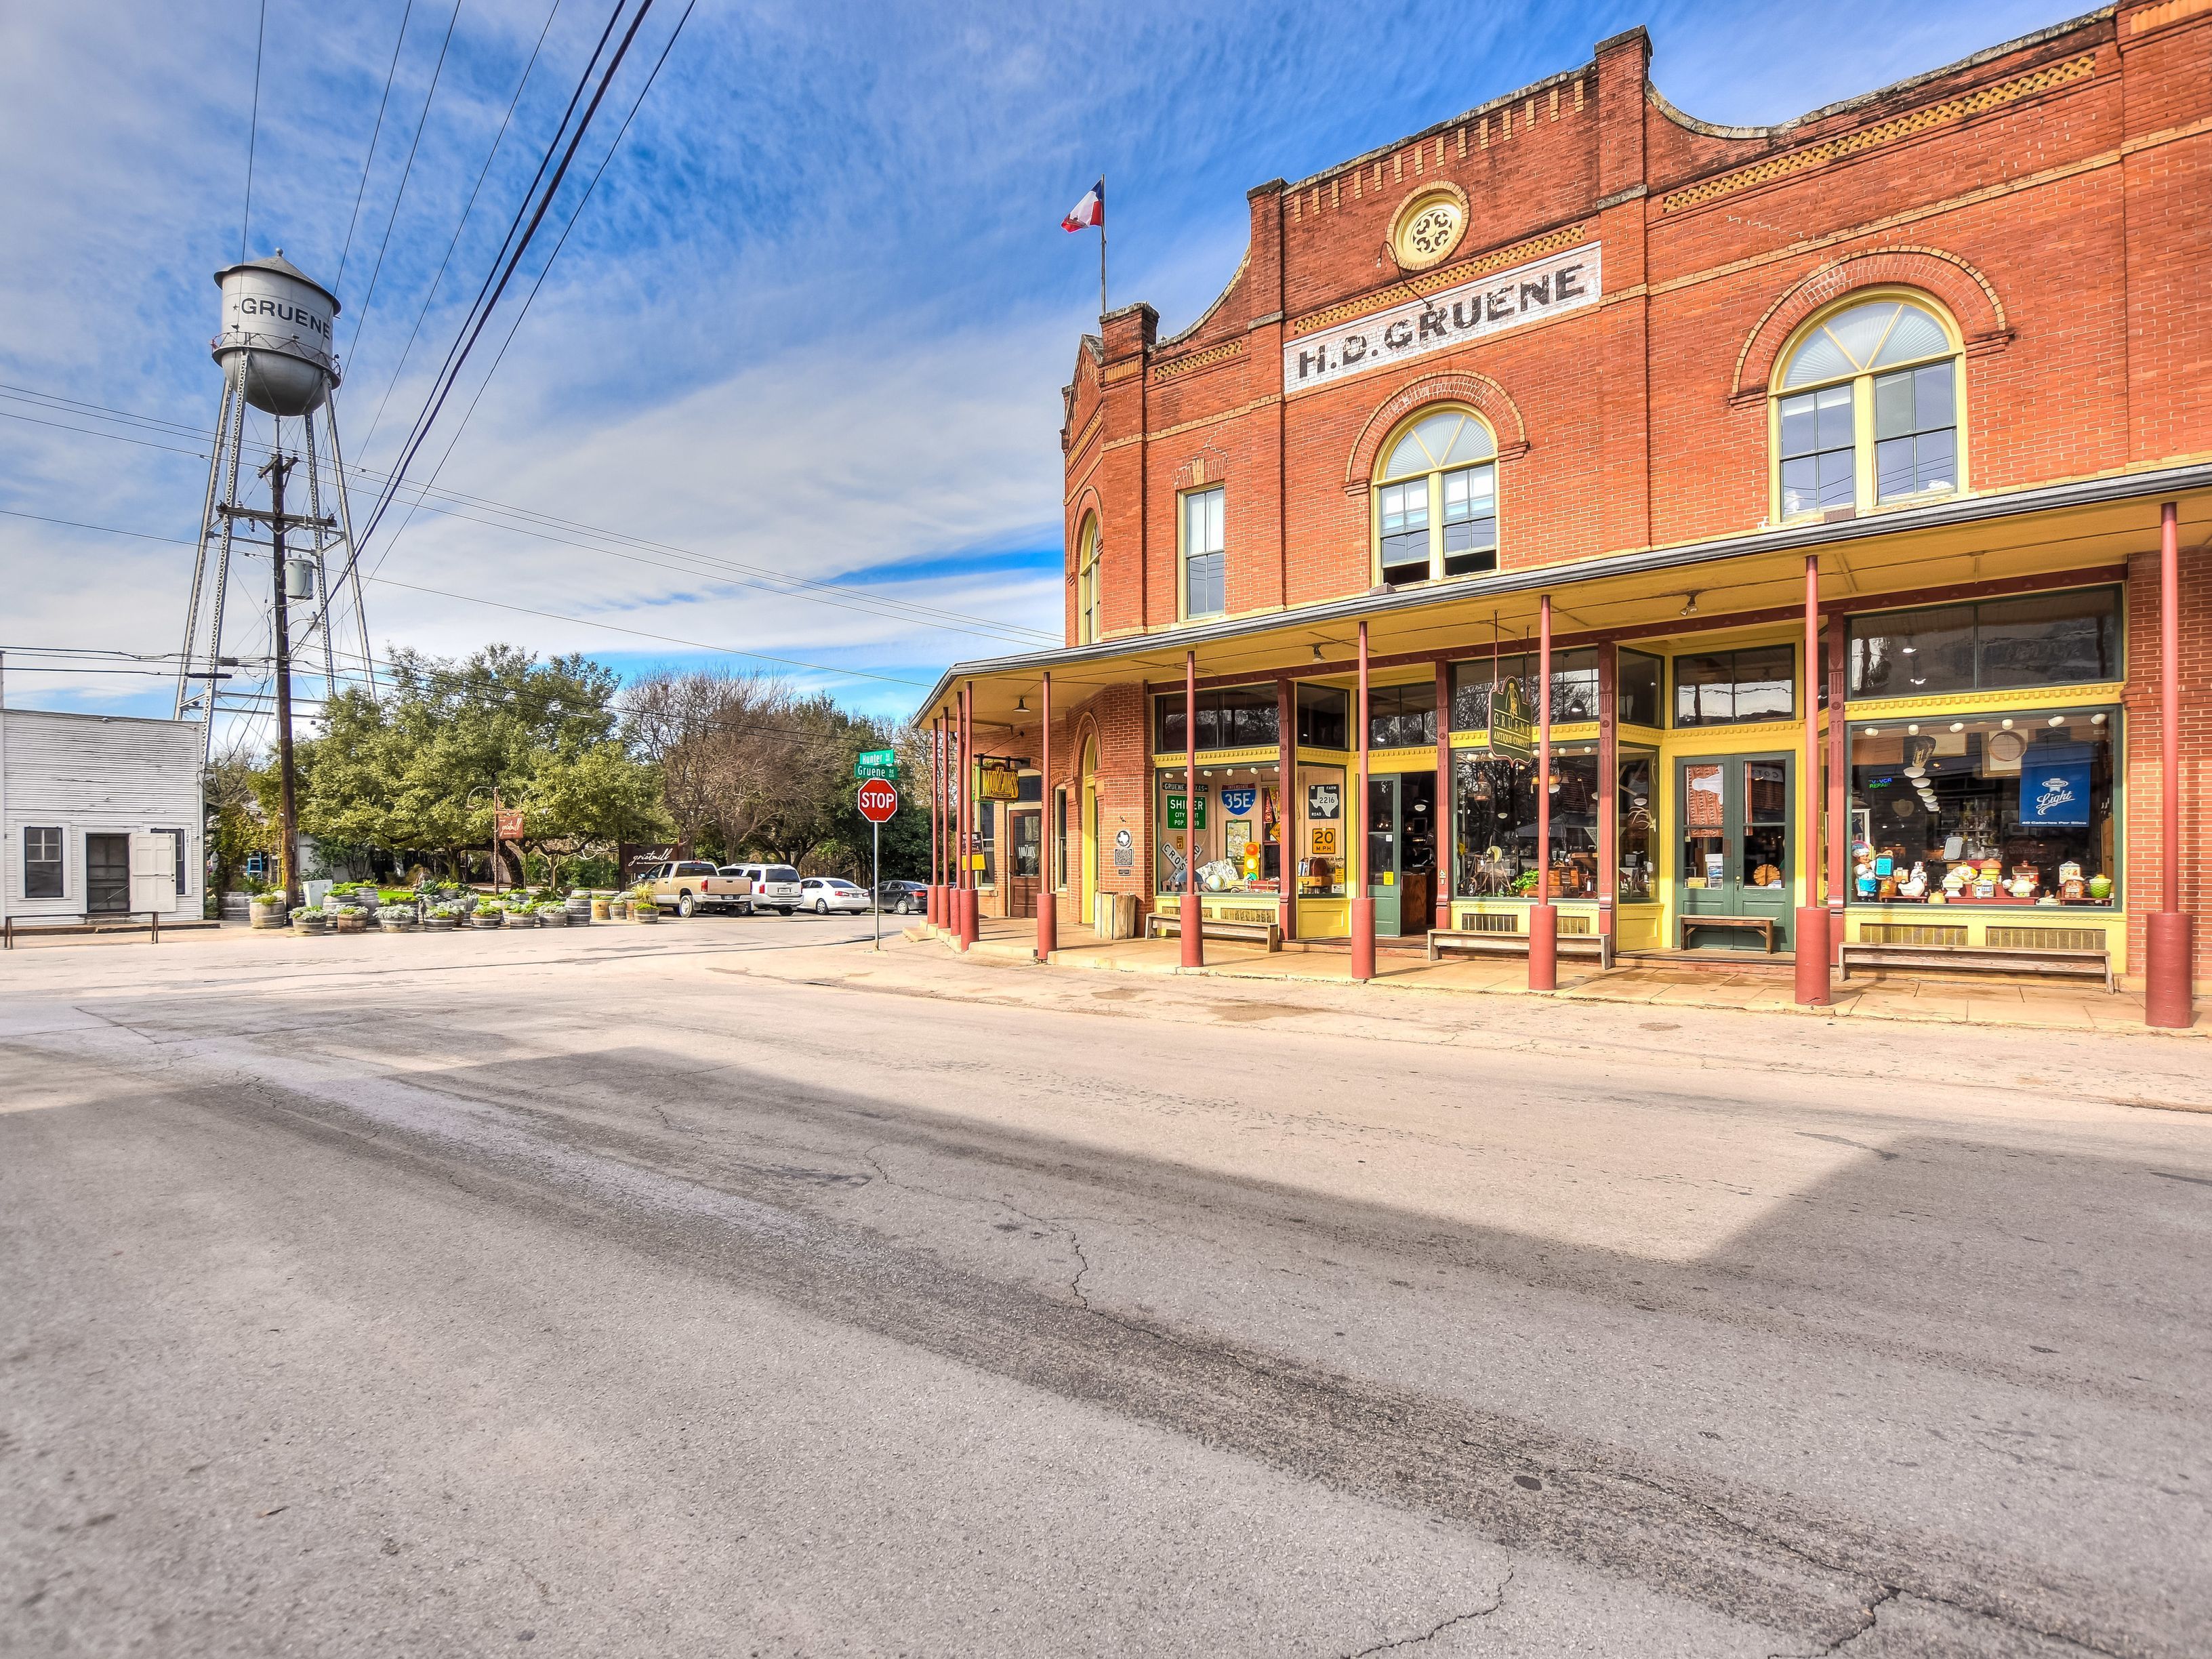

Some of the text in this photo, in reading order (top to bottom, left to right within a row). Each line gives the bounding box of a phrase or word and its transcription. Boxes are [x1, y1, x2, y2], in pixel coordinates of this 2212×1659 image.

[1385, 264, 1584, 350] GRUENE
[241, 298, 331, 340] GRUENE
[1494, 712, 1530, 735] GRUENE
[1494, 731, 1530, 749] ANTIQUE COMPANY
[862, 753, 883, 764] Hunter
[857, 766, 886, 777] Gruene
[861, 792, 895, 809] STOP
[1170, 799, 1204, 811] SHIER
[1224, 793, 1252, 808] 35E
[2036, 790, 2074, 809] Light
[1314, 831, 1334, 844] 20
[628, 848, 673, 866] gristmill
